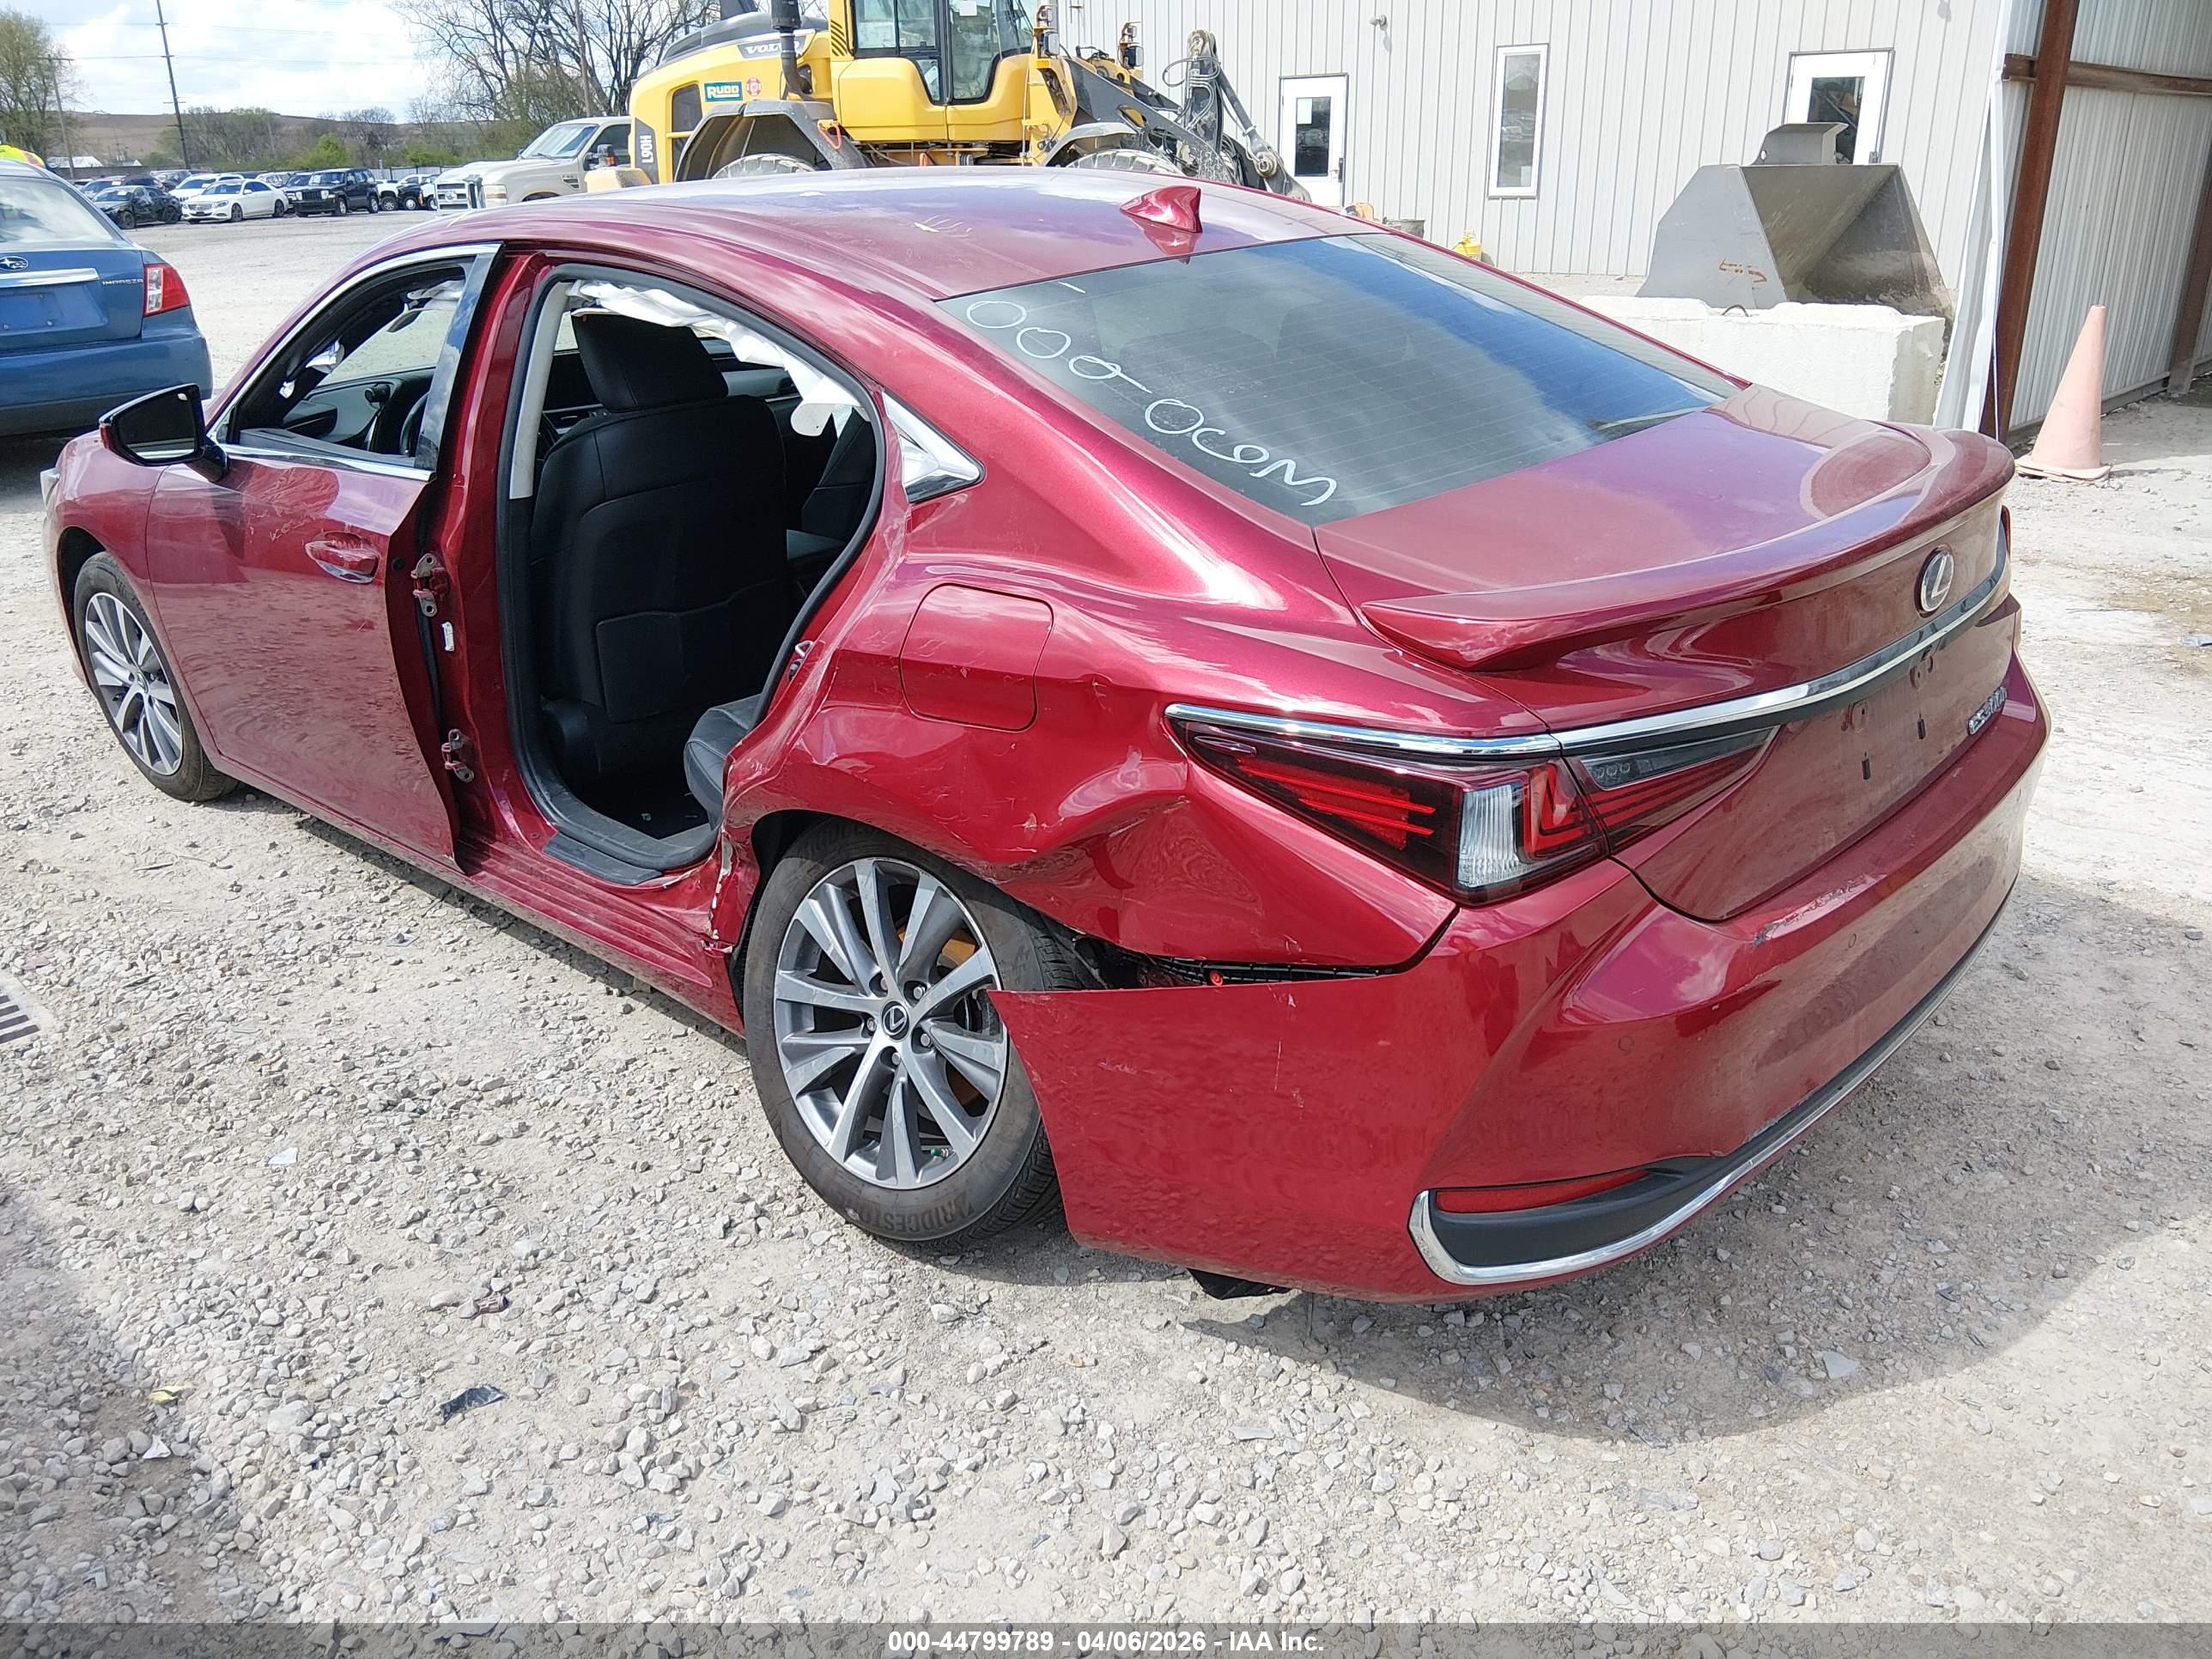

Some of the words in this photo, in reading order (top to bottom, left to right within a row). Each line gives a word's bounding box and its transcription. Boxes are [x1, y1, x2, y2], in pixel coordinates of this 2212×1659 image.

[745, 40, 799, 55] VOLO
[707, 85, 740, 99] RUDD
[640, 135, 654, 163] L90H
